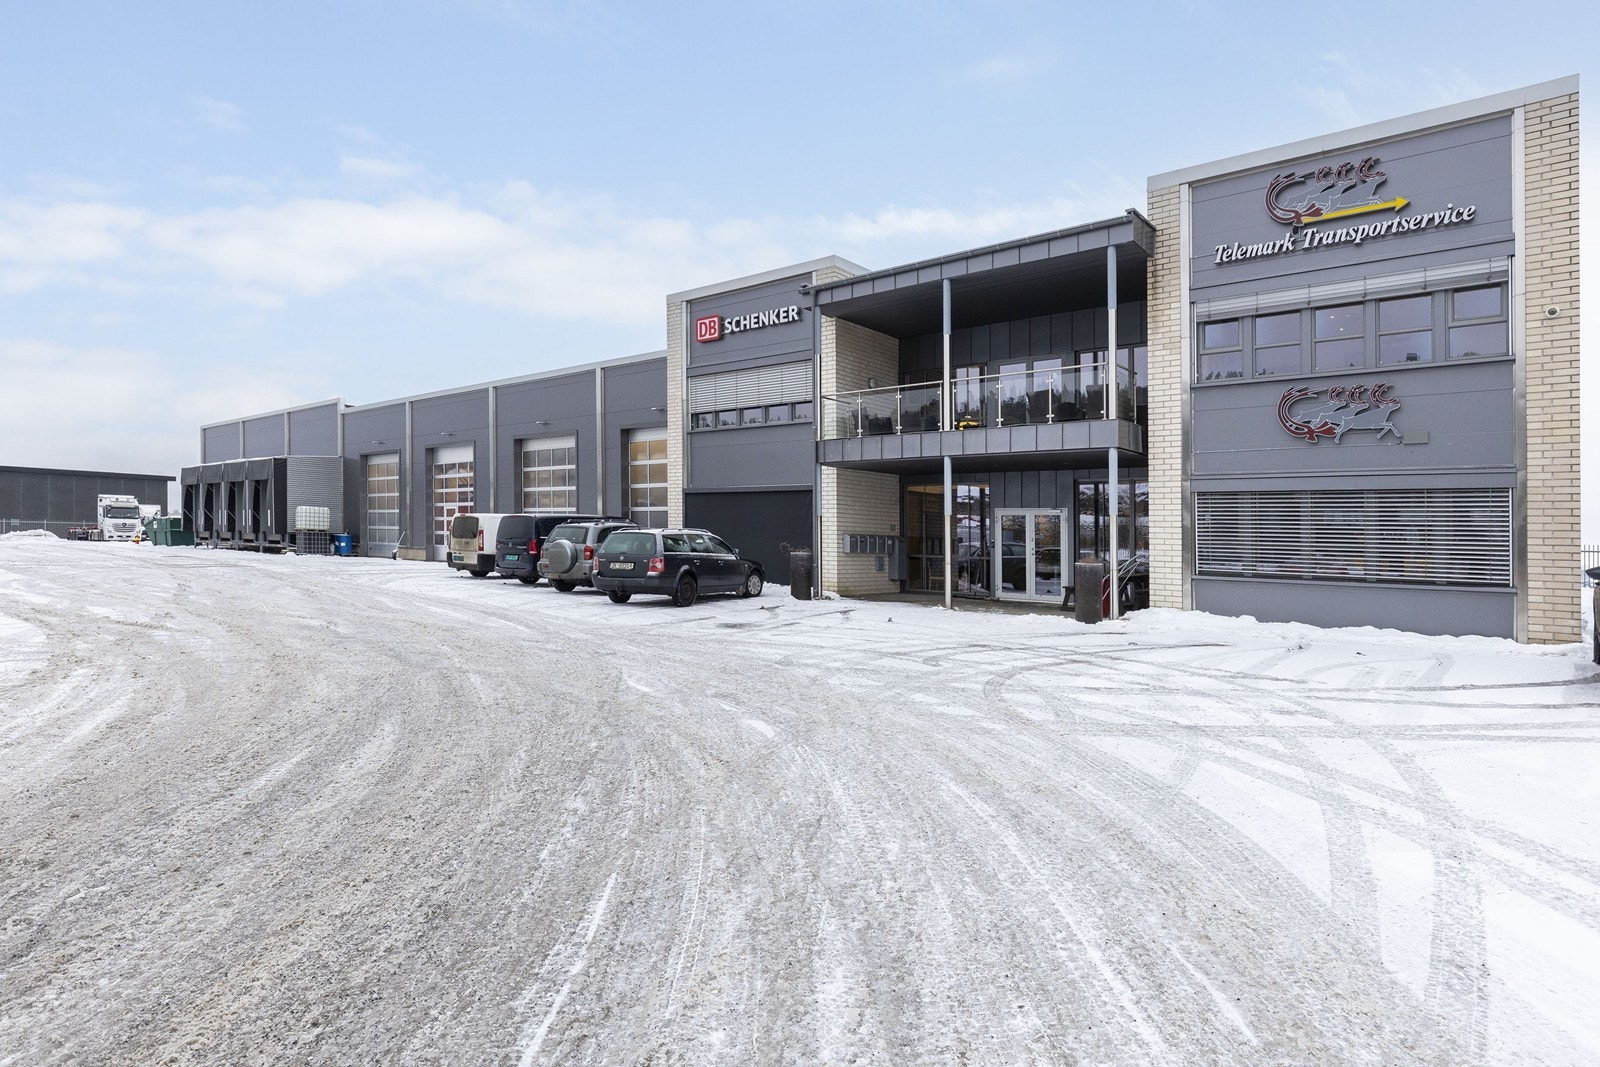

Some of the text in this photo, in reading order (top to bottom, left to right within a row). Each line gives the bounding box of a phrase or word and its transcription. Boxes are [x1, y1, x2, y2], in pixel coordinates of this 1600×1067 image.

[1214, 203, 1476, 264] Telemark Transportservice
[699, 305, 799, 338] DB SCHENKER
